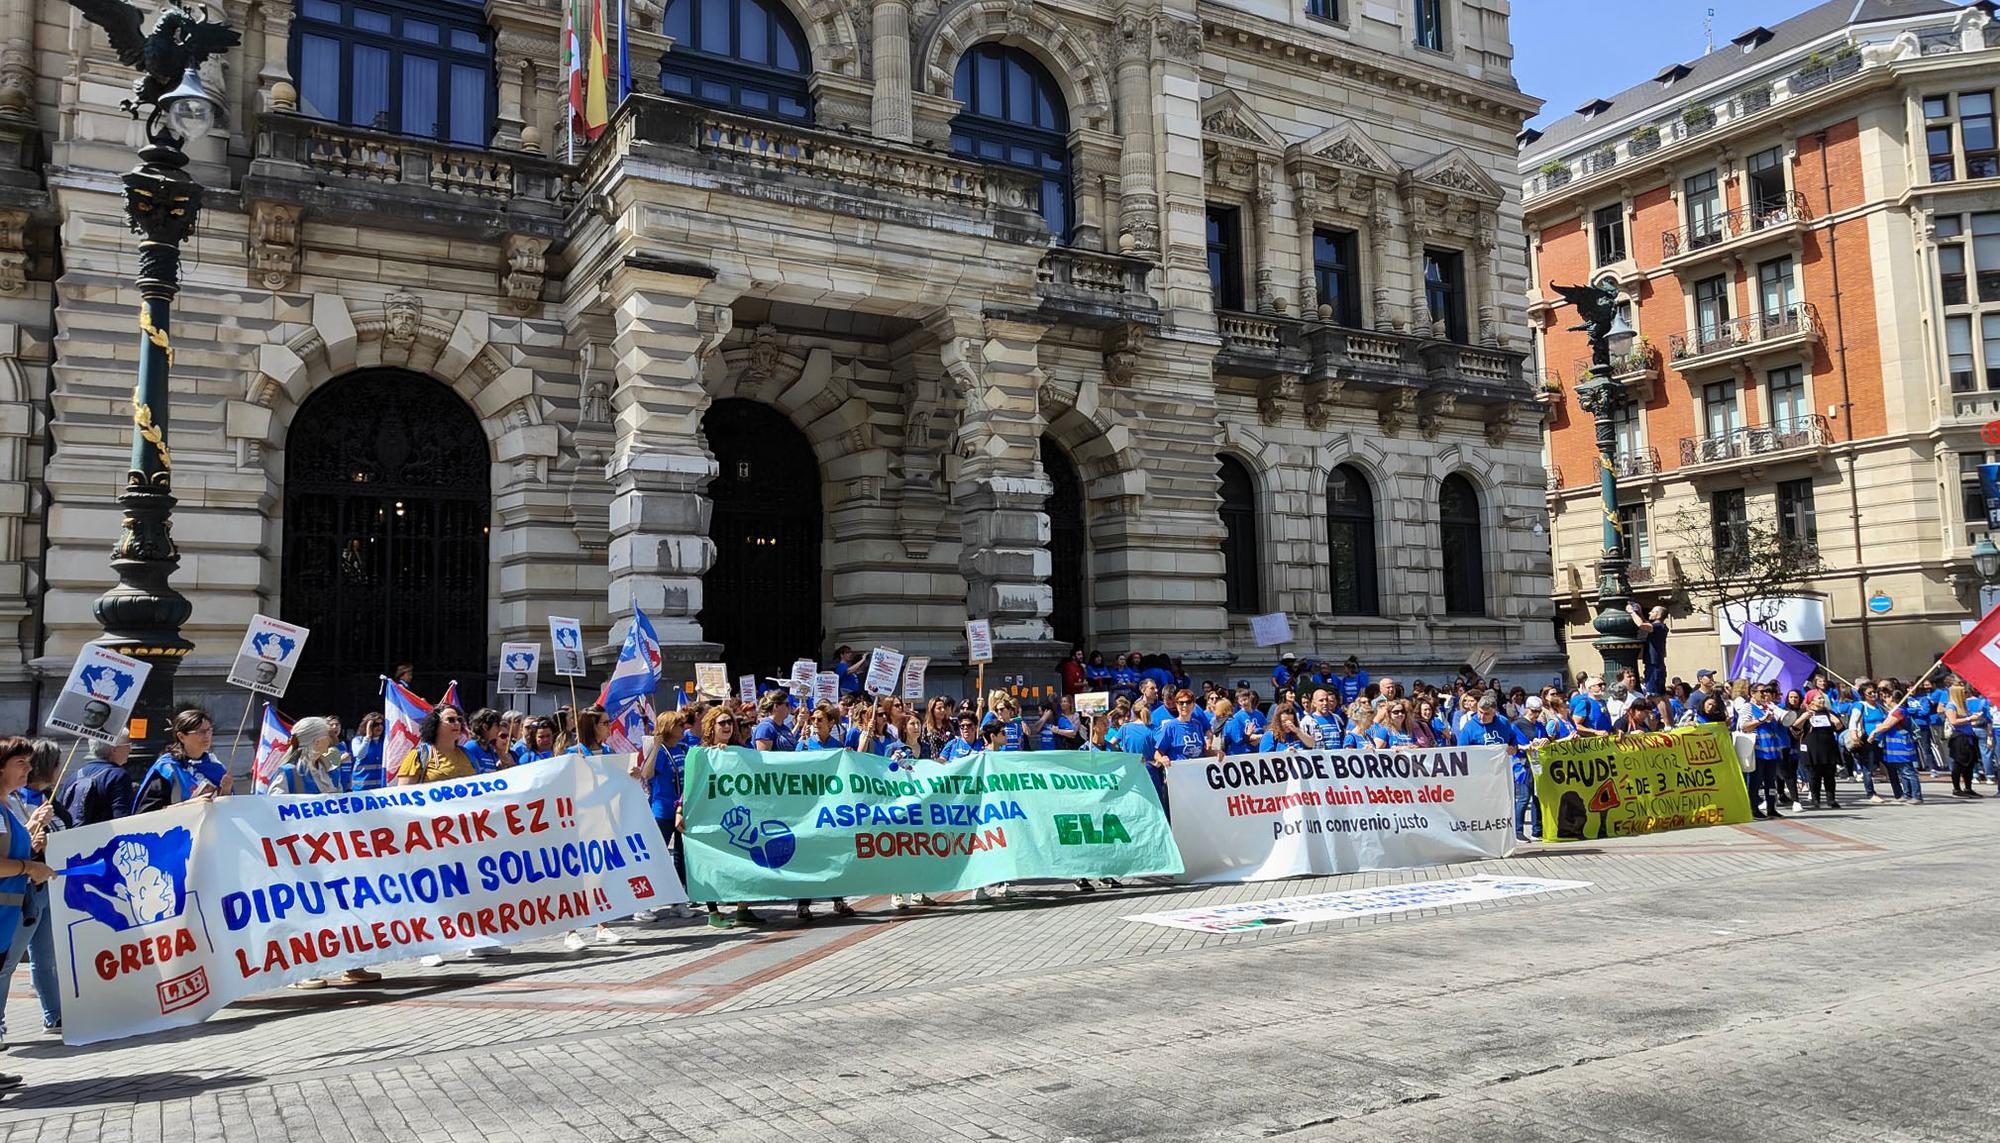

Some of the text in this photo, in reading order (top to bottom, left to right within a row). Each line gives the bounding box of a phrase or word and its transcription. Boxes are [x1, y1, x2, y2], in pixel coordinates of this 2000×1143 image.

[1206, 751, 1469, 790] GORABIDE BORROKAN
[1549, 755, 1618, 787] GAUDE
[1623, 756, 1640, 770] en
[708, 772, 1119, 799] ¡CONVENIO DIGNO! HITZARMEN DUINA!
[1636, 776, 1650, 795] DE
[1656, 773, 1667, 790] 3
[1677, 767, 1716, 790] AÑOS
[278, 779, 508, 821] MERCEDARIAS OROZKO
[816, 801, 1028, 829] ASPACE BIZKAIA
[1227, 784, 1455, 816] Hitzarmen duin baten alde
[1624, 793, 1711, 819] SIN CONVENIO
[261, 808, 498, 868] ITXIERARIK
[505, 799, 550, 836] EZ
[1054, 814, 1132, 845] ELA
[1307, 819, 1322, 834] un
[1326, 813, 1391, 832] convenio
[1394, 813, 1428, 834] justo
[855, 827, 1007, 859] BORROKAN
[221, 862, 470, 931] DIPUTACION
[477, 840, 626, 891] SOLUCION
[235, 917, 434, 978] LANGILEOK
[438, 890, 590, 940] BORROKAN
[95, 928, 197, 980] GREBA
[161, 971, 206, 1005] LAB
